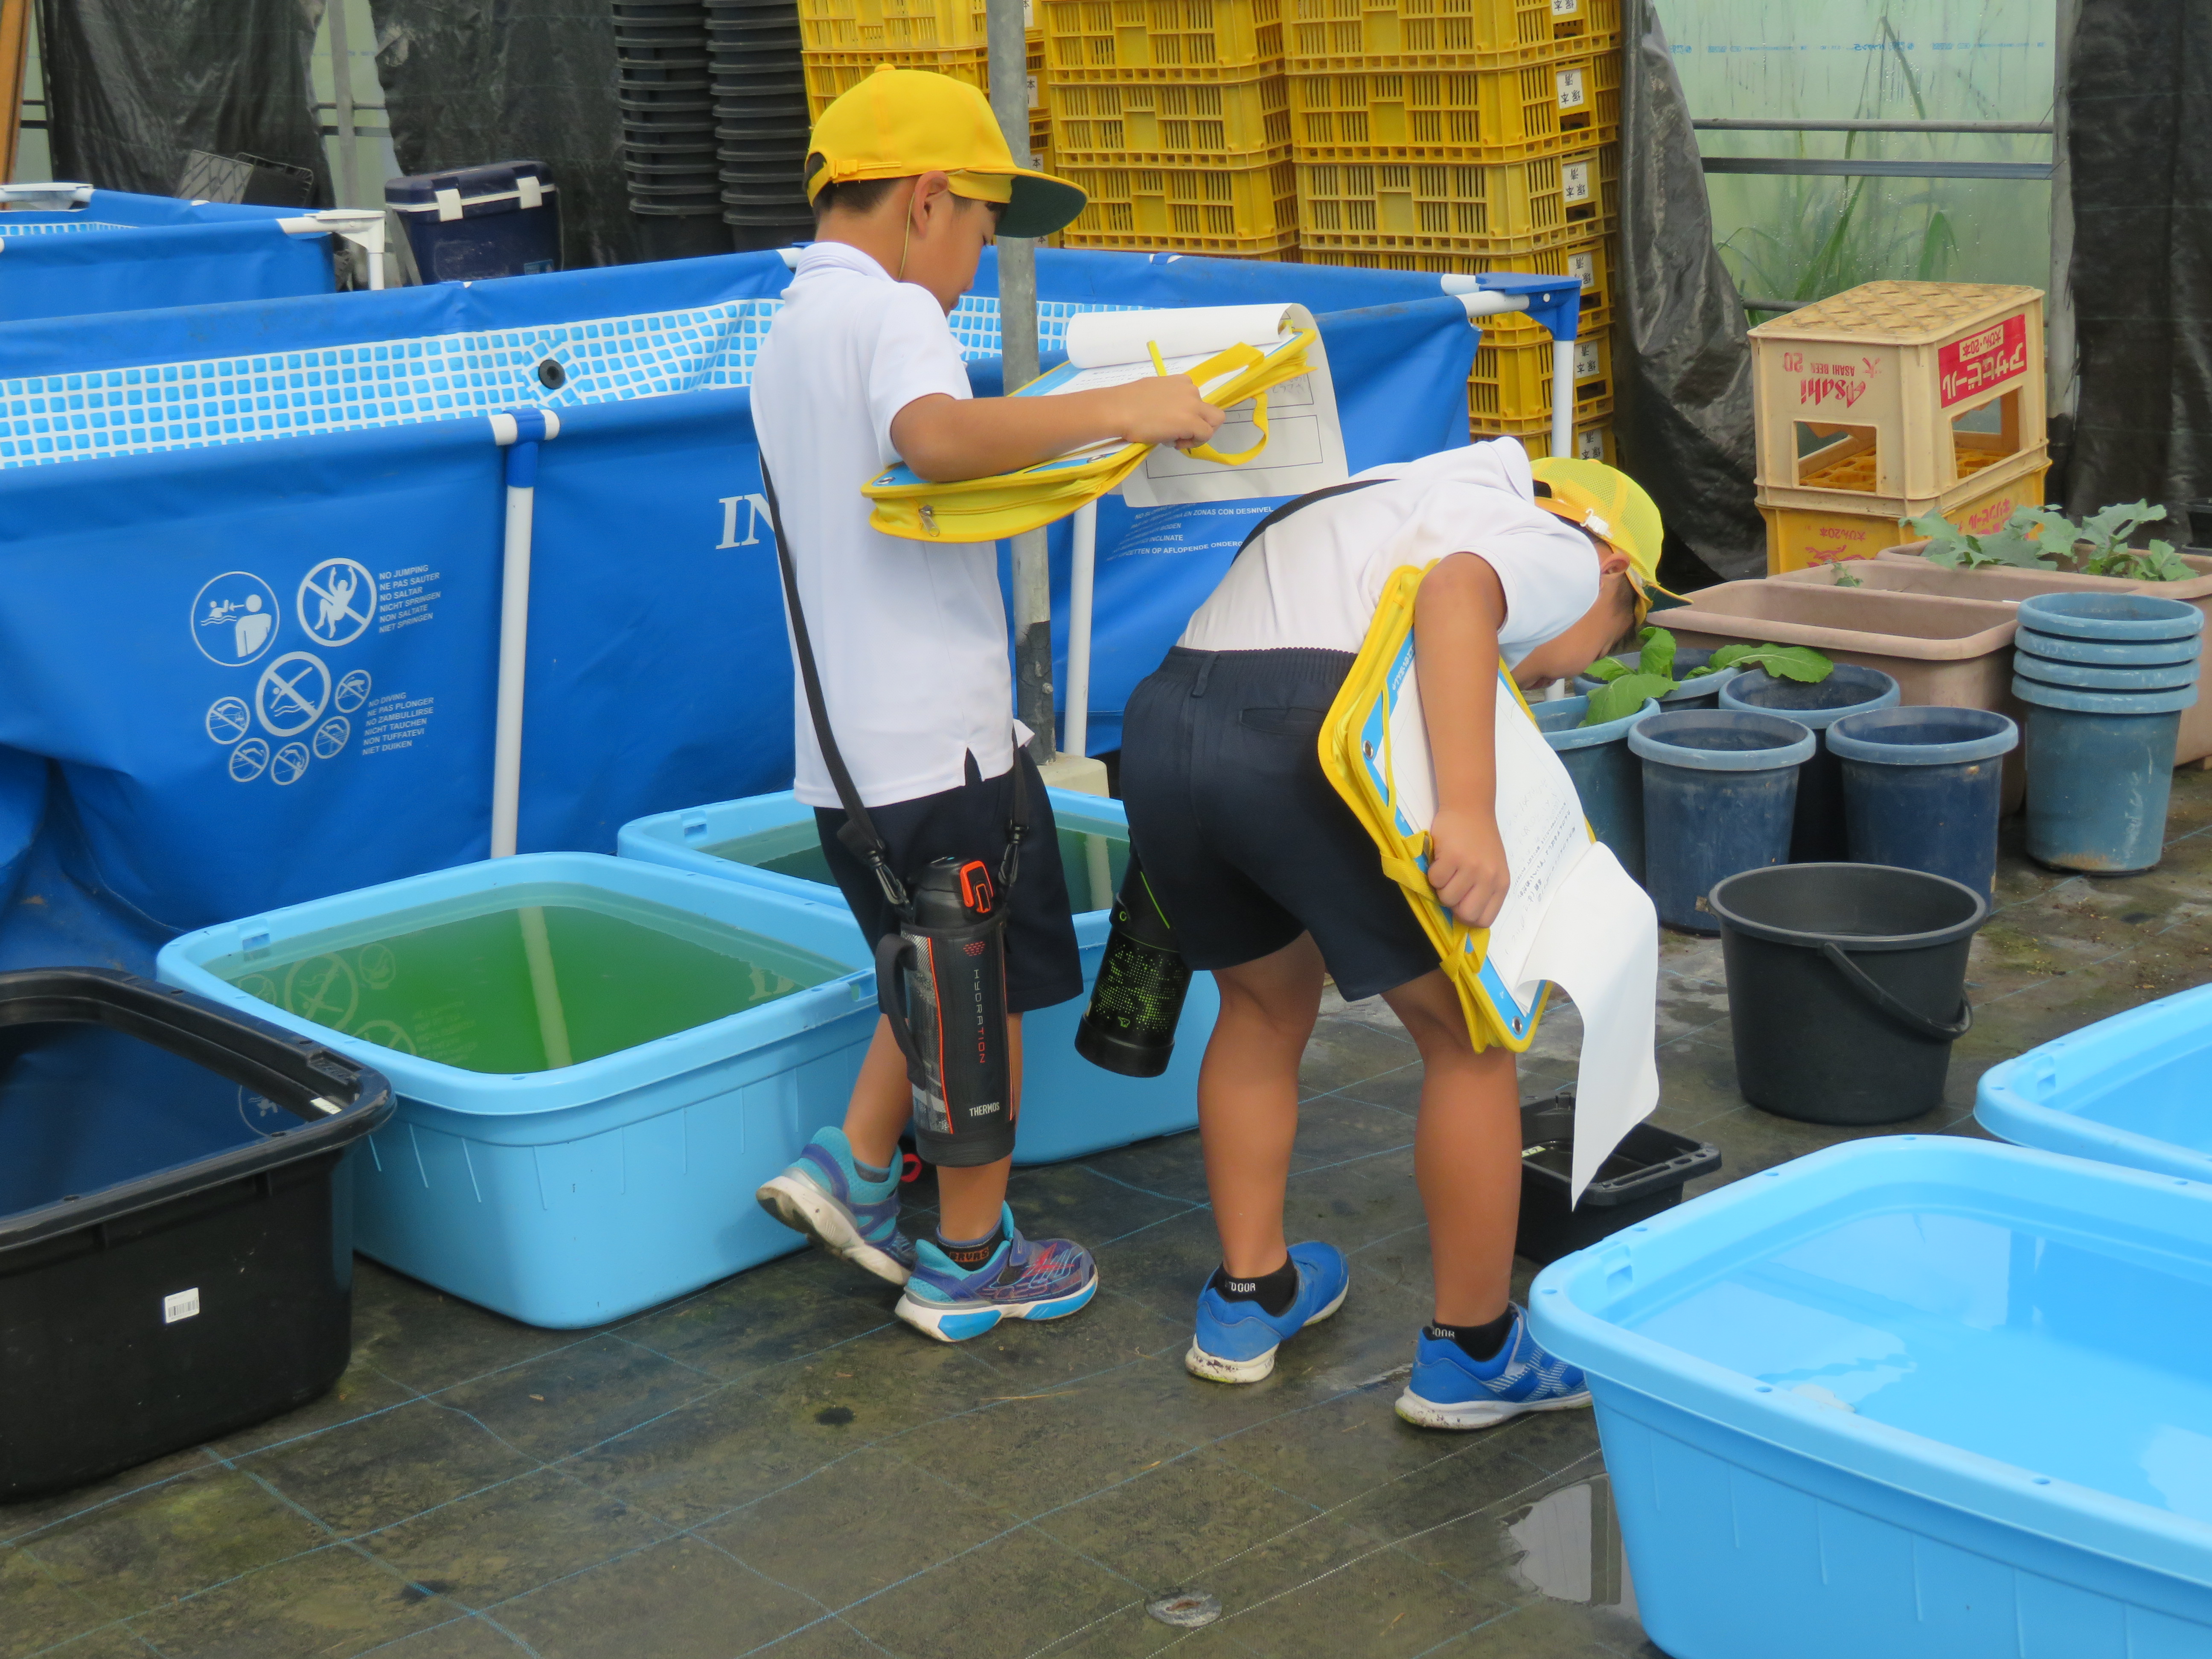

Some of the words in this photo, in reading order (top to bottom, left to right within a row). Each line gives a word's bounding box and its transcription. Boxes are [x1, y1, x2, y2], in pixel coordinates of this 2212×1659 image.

[1784, 352, 1803, 373] 20
[1810, 362, 1829, 375] BEER
[1833, 364, 1855, 377] ASAHI
[1862, 357, 1882, 378] 大
[1942, 342, 2025, 400] アサヒビール
[1800, 378, 1866, 409] Asahi
[1236, 506, 1274, 514] DESNIVEL
[1160, 523, 1182, 531] BODEN
[1819, 526, 1866, 541] 大びん20本
[1163, 544, 1209, 554] AFLOPENDE
[379, 571, 392, 580] NO
[394, 565, 429, 577] JUMPING
[380, 582, 391, 591] NE
[393, 579, 408, 588] PAS
[410, 572, 440, 585] SAUTER
[380, 593, 392, 601] NO
[394, 587, 423, 599] SALTAR
[380, 601, 403, 612] NICHT
[405, 591, 441, 607] SPRINGEN
[380, 613, 397, 623] NON
[398, 604, 428, 618] SALTATE
[379, 623, 396, 633] NIET
[397, 612, 434, 628] SPRINGEN
[367, 708, 377, 717] NE
[378, 704, 394, 713] PAS
[395, 697, 434, 710] PLONGER
[369, 699, 380, 707] NO
[381, 692, 407, 704] DIVING
[366, 718, 377, 727] NO
[378, 707, 434, 724] ZAMBULLIRSE
[364, 725, 387, 736] NICHT
[390, 718, 427, 731] TAUCHEN
[363, 736, 381, 745] NON
[383, 728, 425, 742] TUFFATEVI
[362, 745, 381, 756] NIET
[382, 740, 413, 751] DUIKEN
[973, 969, 986, 1064] HYDRATION
[969, 1101, 1000, 1117] THERMOS
[1228, 1281, 1256, 1293] DOOR
